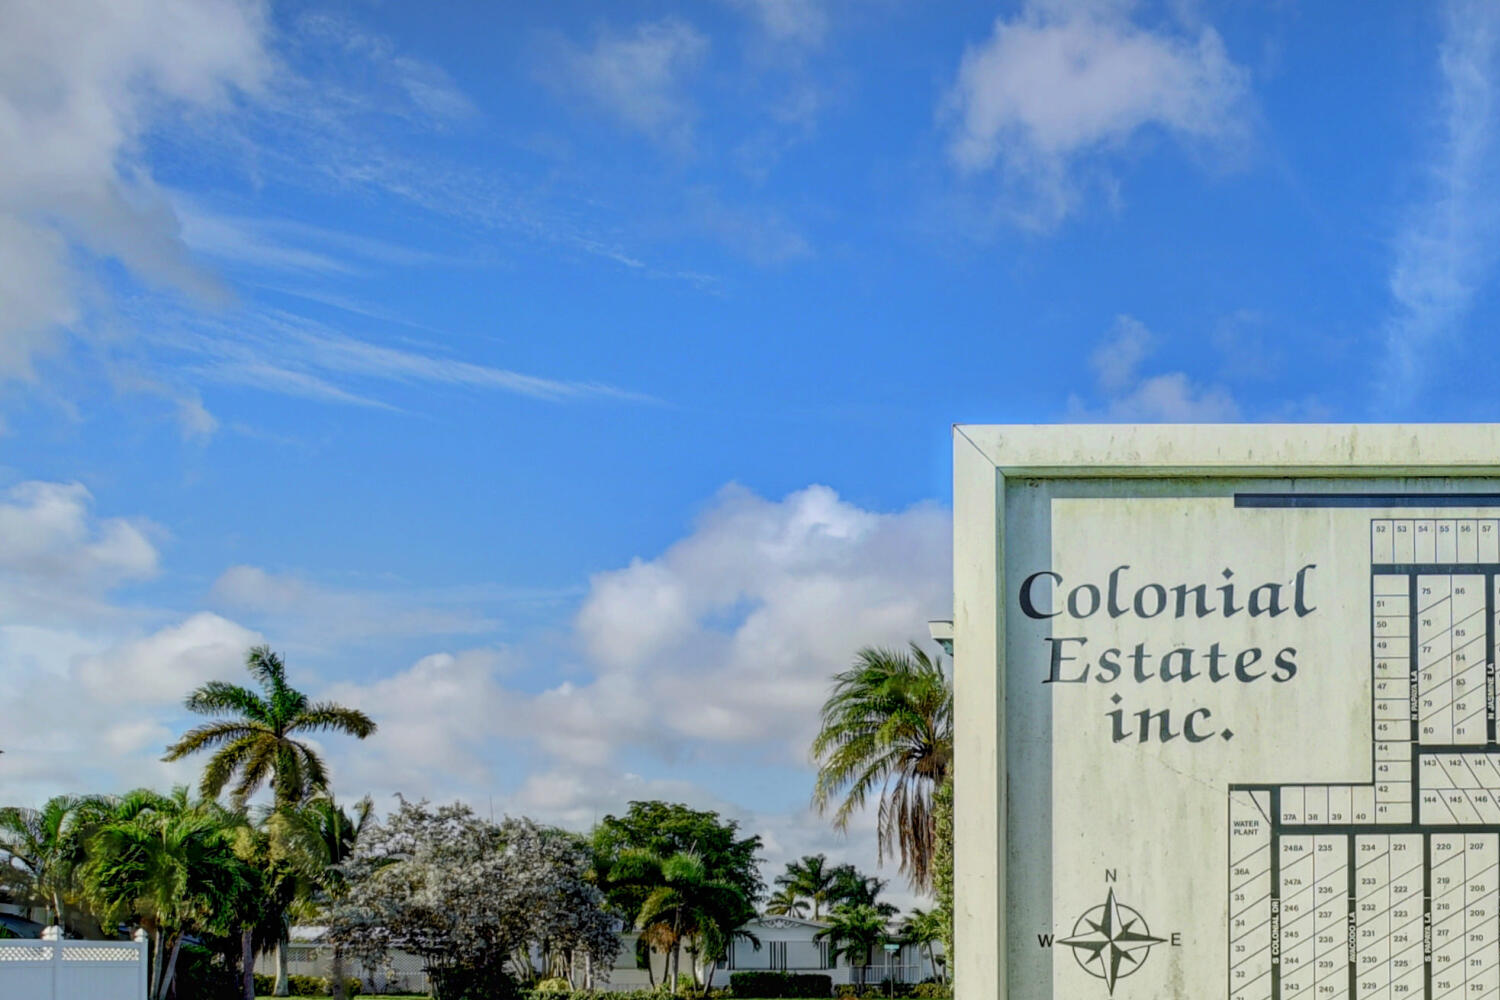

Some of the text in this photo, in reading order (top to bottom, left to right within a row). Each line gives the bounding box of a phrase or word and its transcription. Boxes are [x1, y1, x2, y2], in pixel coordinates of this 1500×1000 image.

[1440, 525, 1449, 533] 55
[1019, 564, 1317, 620] Colonial
[1422, 587, 1431, 595] 75
[1377, 641, 1387, 649] 49
[1041, 636, 1297, 684] Estates
[1487, 663, 1494, 675] LA
[1410, 670, 1418, 682] LA
[1104, 692, 1234, 744] inc.
[1487, 712, 1494, 720] N
[1105, 868, 1117, 883] N
[1272, 901, 1279, 913] DR
[1349, 911, 1355, 923] LA
[1424, 912, 1431, 924] LA
[1037, 933, 1055, 948] W
[1171, 932, 1182, 947] E
